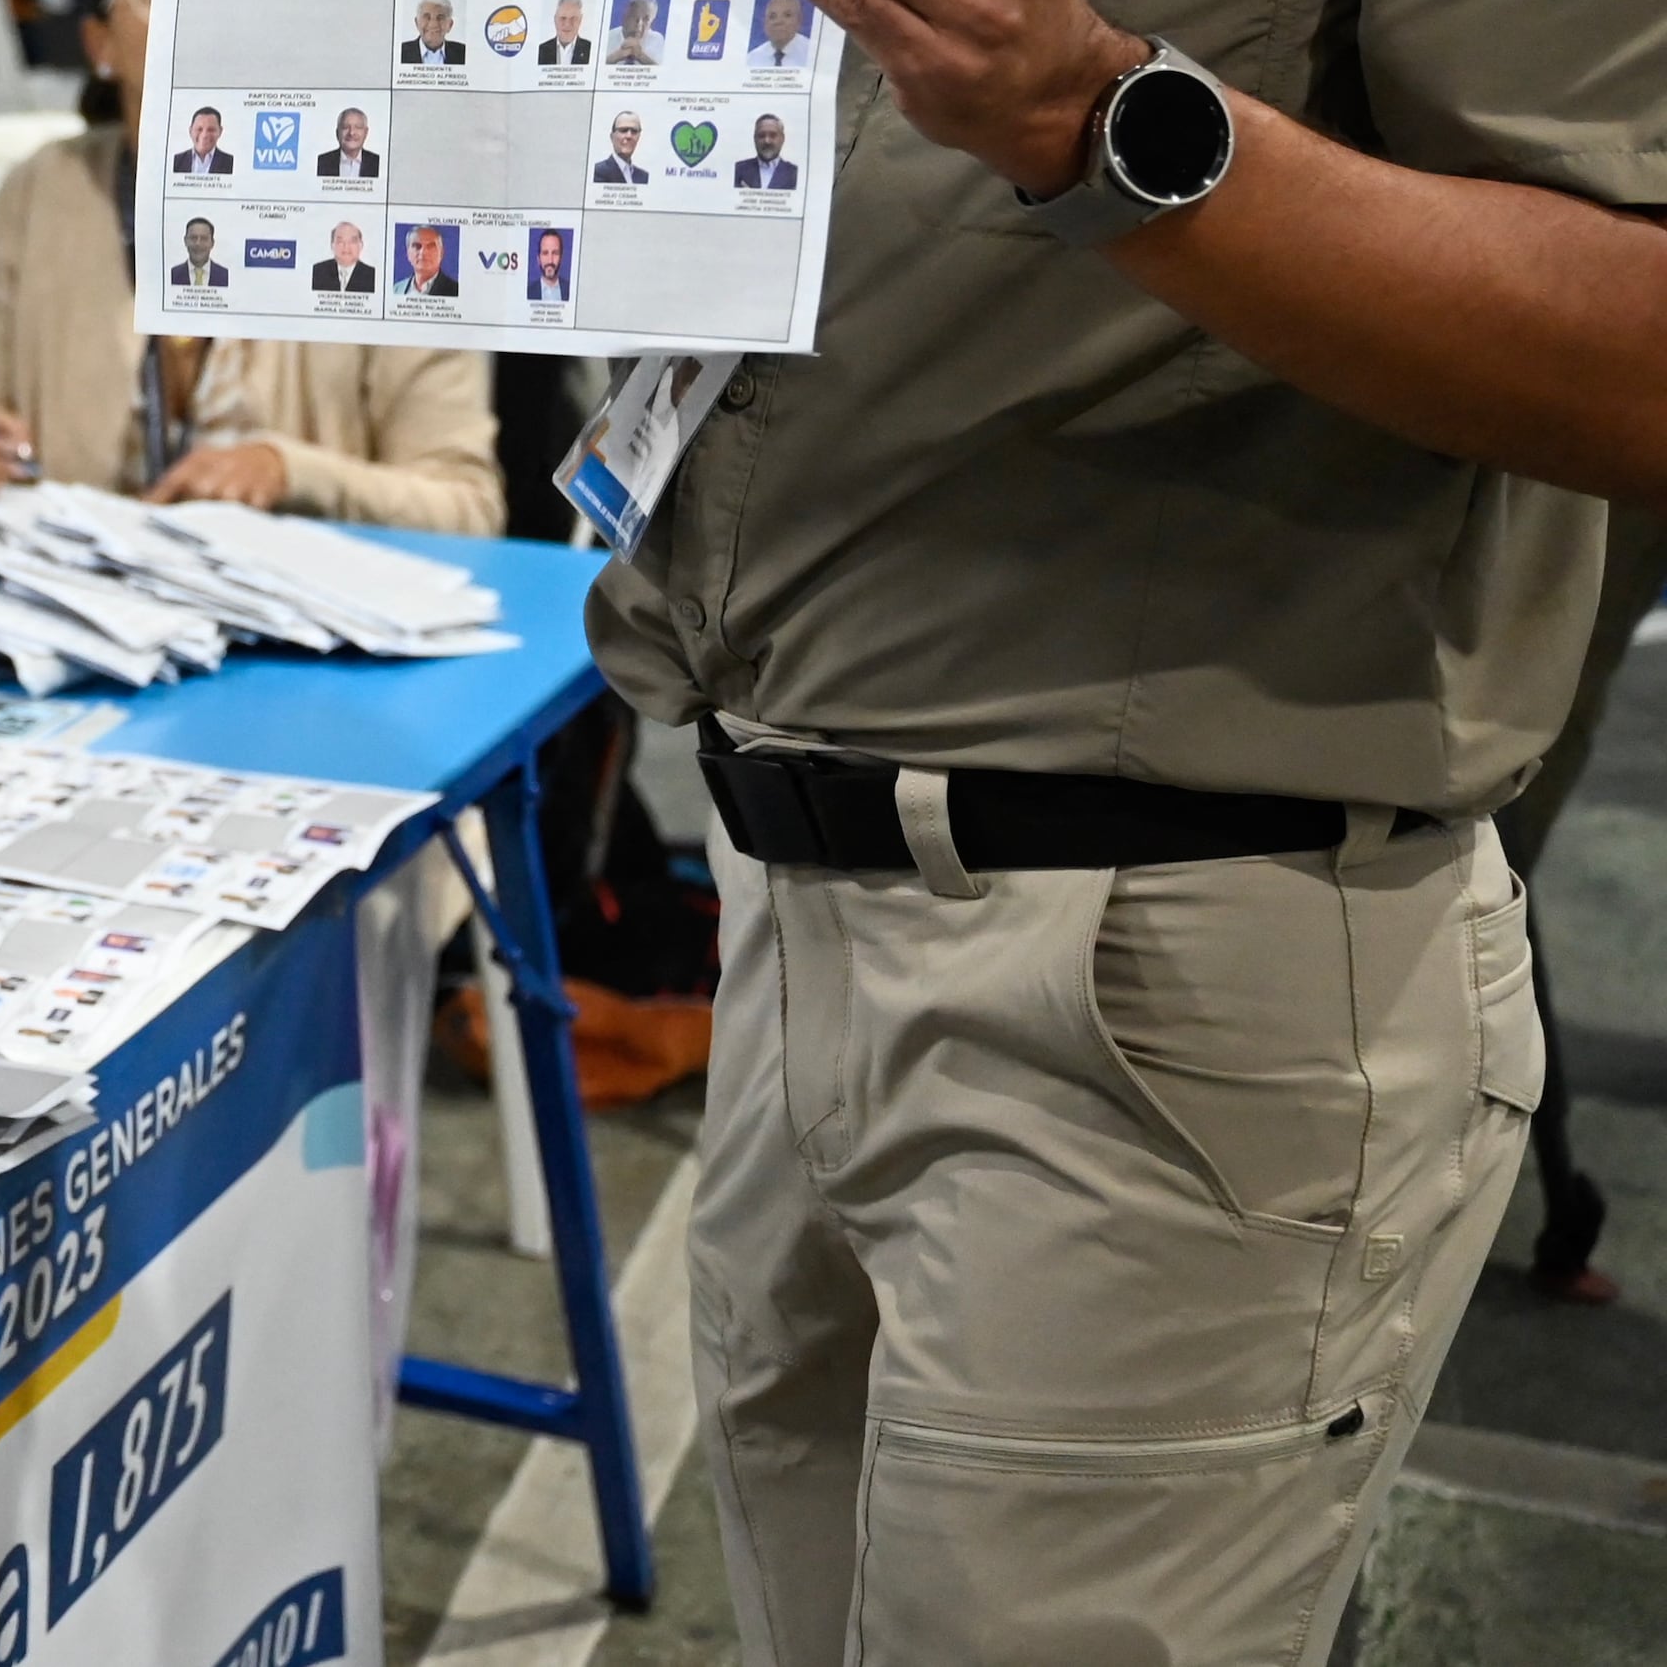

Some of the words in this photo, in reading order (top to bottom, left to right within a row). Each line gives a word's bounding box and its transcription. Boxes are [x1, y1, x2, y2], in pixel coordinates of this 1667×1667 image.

[691, 43, 720, 54] BIEN
[256, 149, 295, 164] VIVA
[665, 167, 678, 177] Mi
[679, 167, 717, 179] Familia
[273, 205, 305, 213] POLITICO
[427, 218, 470, 226] VOLUNTAD,
[250, 247, 291, 259] CAMBIO
[478, 250, 518, 270] VOS
[64, 1011, 247, 1214] GENERALES
[68, 1328, 215, 1594] 1,875
